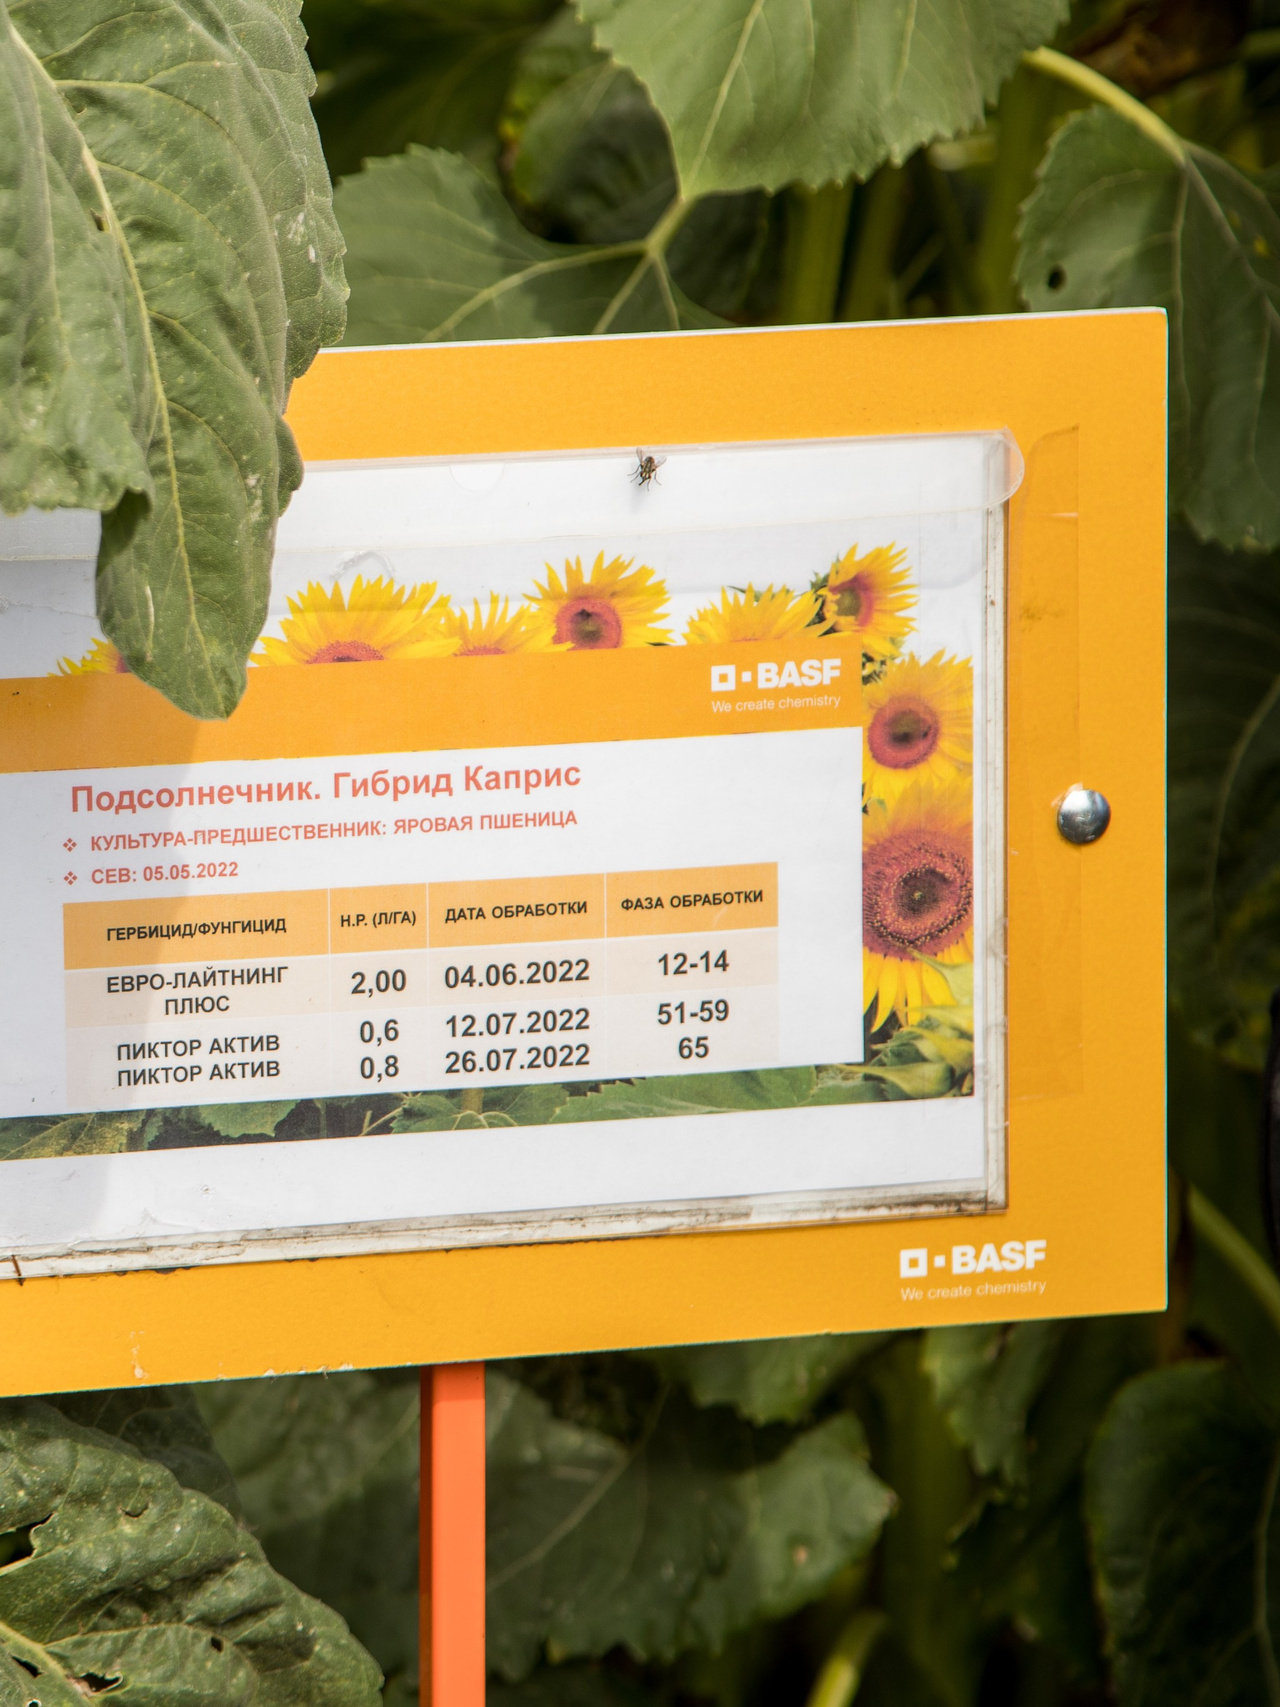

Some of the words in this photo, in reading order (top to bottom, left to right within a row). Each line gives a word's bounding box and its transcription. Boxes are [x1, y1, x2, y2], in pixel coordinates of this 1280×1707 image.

[758, 658, 841, 689] BASF
[712, 701, 732, 712] We
[735, 699, 775, 711] create
[778, 695, 840, 709] chemistry
[72, 781, 320, 814] Подсолнечник.
[334, 770, 453, 801] Гибрид
[465, 766, 580, 795] Каприс
[91, 821, 386, 851] КУЛЬТУРА-ПРЕДШЕСТВЕННИК:
[394, 816, 472, 834] ЯРОВАЯ
[481, 811, 577, 830] ПШЕНИЦА
[92, 868, 136, 884] СЕВ:
[143, 862, 238, 881] 05.05.2022
[445, 907, 486, 923] ДАТА
[492, 901, 587, 918] ОБРАБОТКИ
[621, 897, 664, 910] ФАЗА
[670, 890, 763, 908] ОБРАБОТКИ
[107, 919, 286, 941] ГЕРБИЦИД/ФУНГИЦИД
[341, 914, 367, 927] Н.Р.
[373, 911, 416, 928] (Л/ГА)
[445, 959, 589, 988] 04.06.2022
[659, 950, 729, 975] 12-14
[107, 967, 288, 993] ЕВРО-ЛАЙТНИНГ
[351, 969, 406, 997] 2,00
[166, 996, 229, 1015] ПЛЮС
[658, 999, 729, 1025] 51-59
[360, 1019, 399, 1046] 0,6
[446, 1008, 589, 1037] 12.07.2022
[118, 1040, 201, 1060] ПИКТОР
[209, 1035, 279, 1054] АКТИВ
[446, 1044, 589, 1073] 26.07.2022
[679, 1036, 709, 1059] 65
[118, 1065, 202, 1086] ПИКТОР
[210, 1061, 280, 1080] АКТИВ
[361, 1055, 399, 1082] 0,8
[952, 1240, 1046, 1274] BASF
[901, 1288, 923, 1301] We
[928, 1285, 972, 1299] create
[976, 1280, 1046, 1295] chemistry
